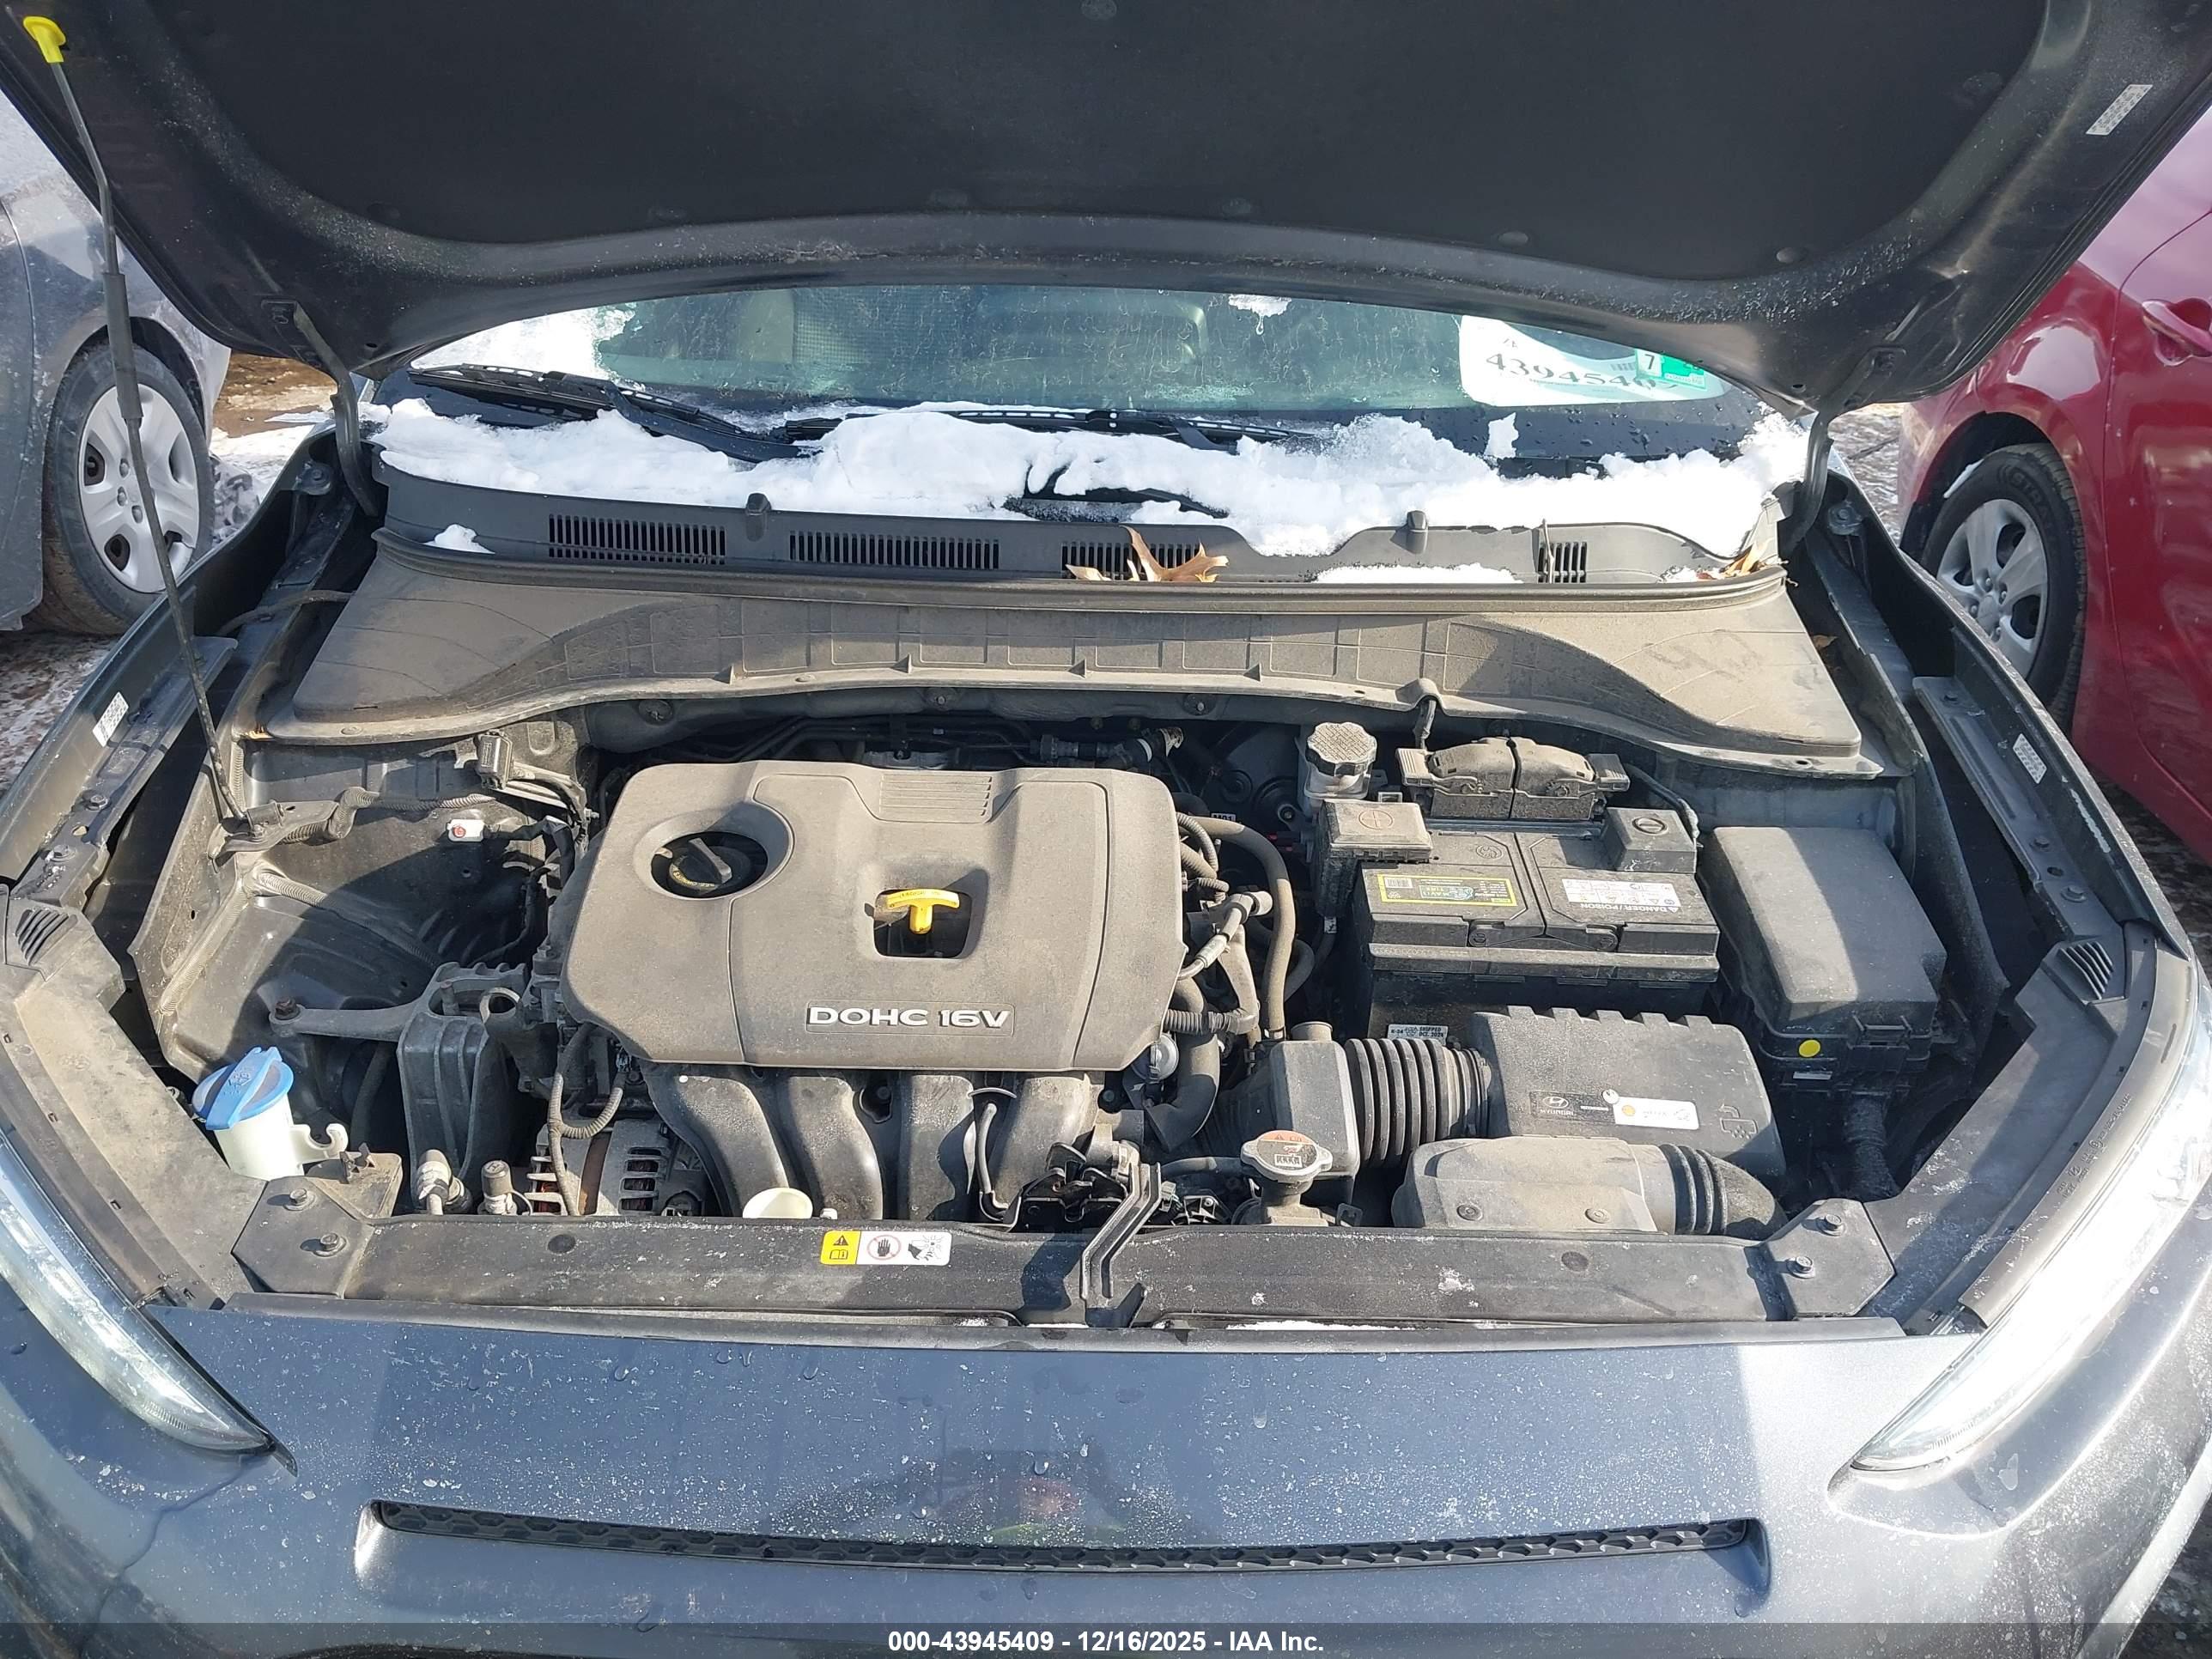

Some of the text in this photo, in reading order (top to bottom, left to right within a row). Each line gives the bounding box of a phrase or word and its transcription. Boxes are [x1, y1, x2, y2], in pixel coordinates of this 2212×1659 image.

[1644, 353, 1656, 370] 7
[806, 1006, 1011, 1029] DOHC 16V
